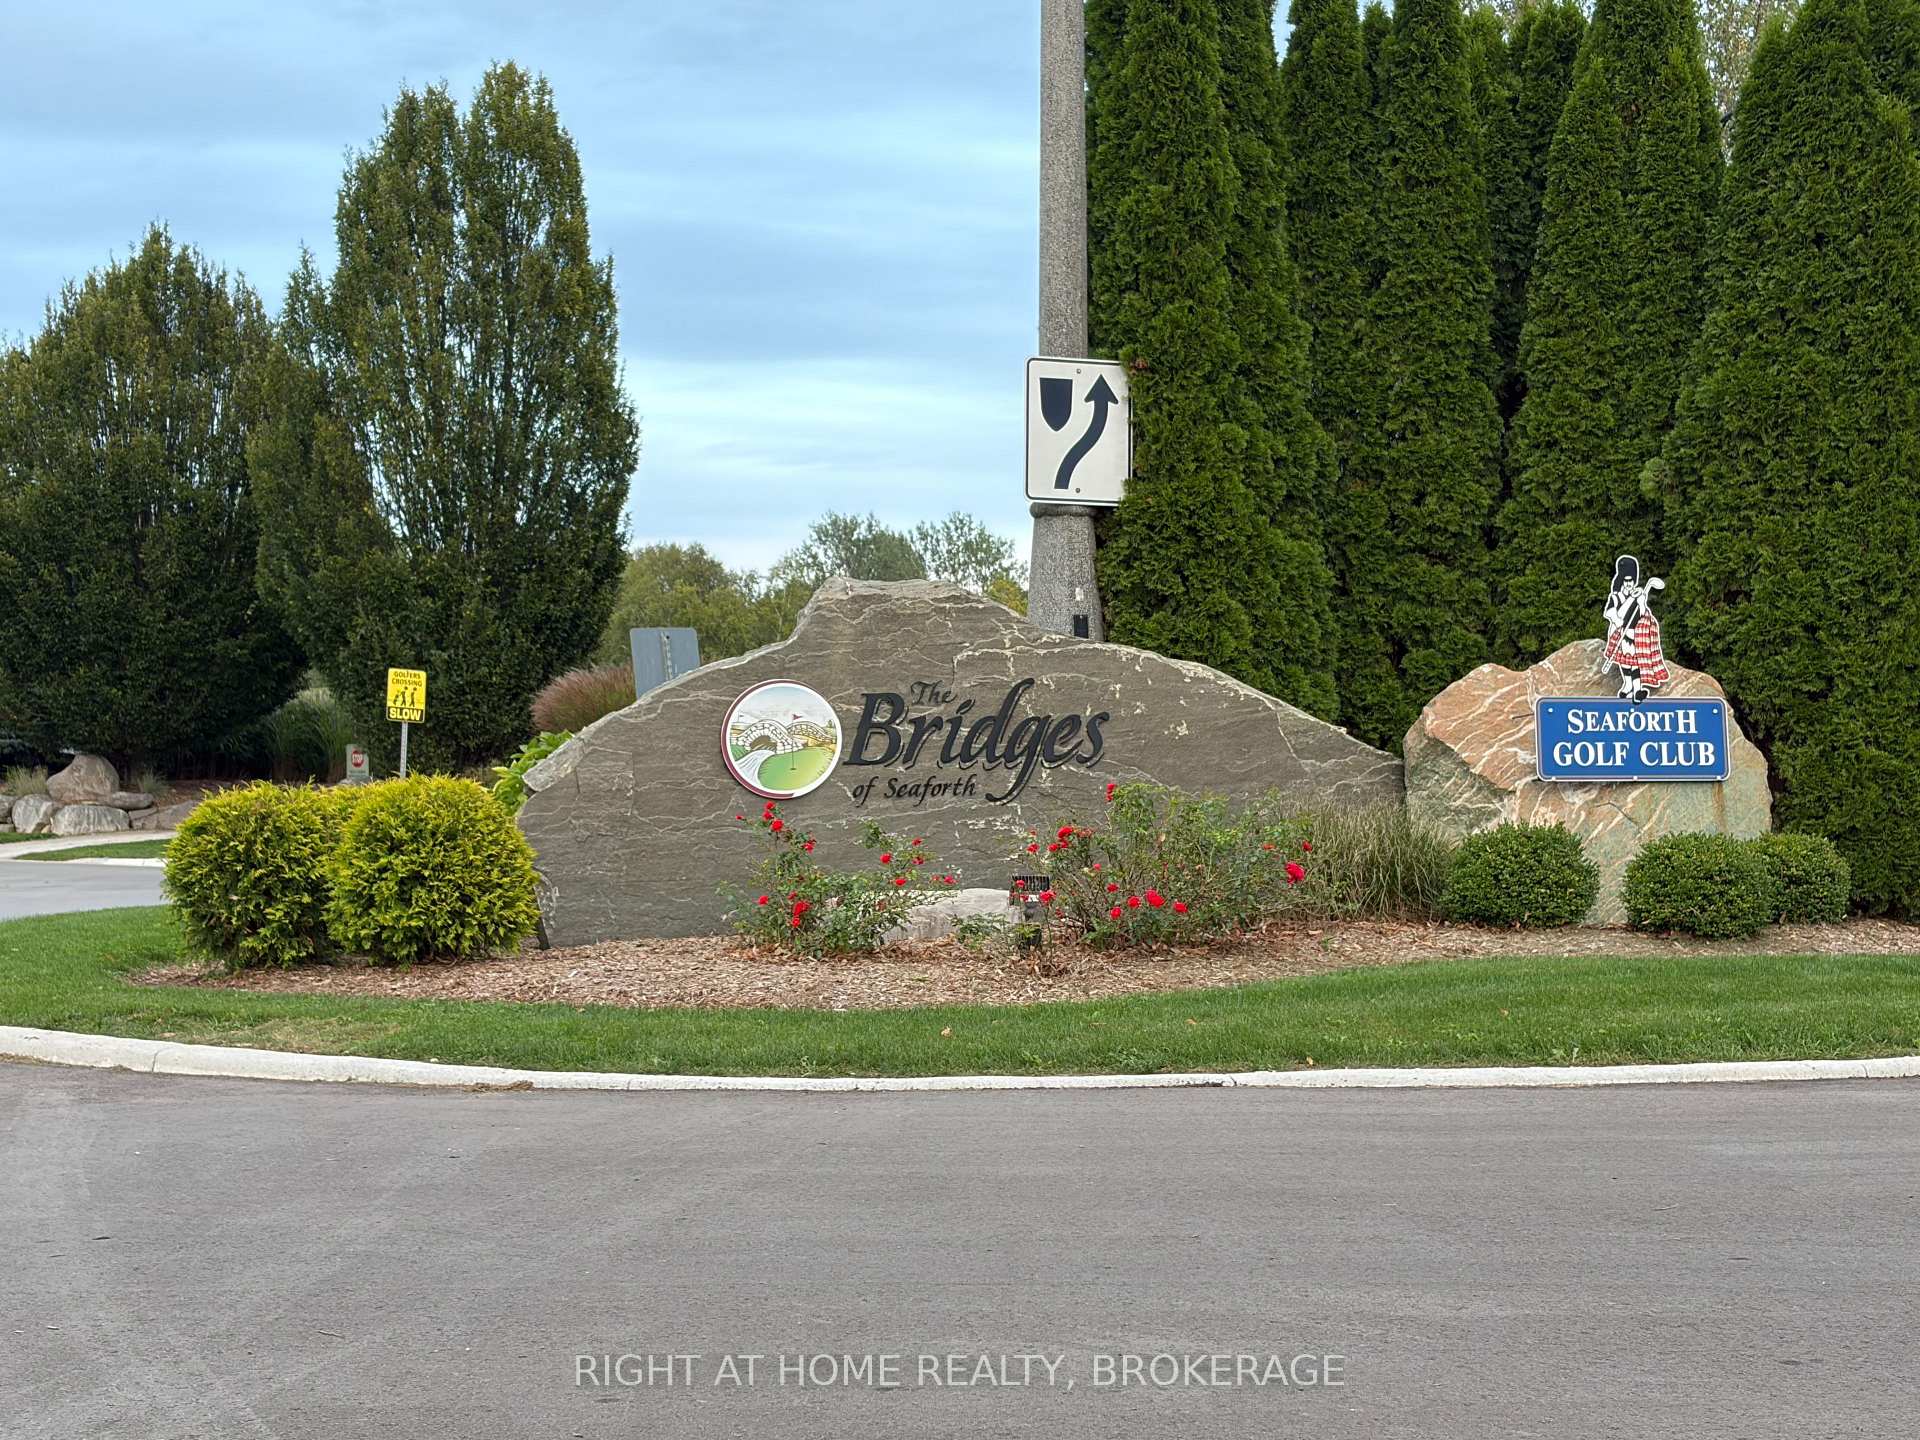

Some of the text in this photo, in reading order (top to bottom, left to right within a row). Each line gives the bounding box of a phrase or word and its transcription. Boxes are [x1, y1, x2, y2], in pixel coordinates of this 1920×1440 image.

[392, 678, 422, 687] CROSSING
[394, 671, 421, 679] GOLFERS
[910, 680, 957, 705] The
[390, 708, 421, 720] SLOW
[842, 677, 1110, 806] Bridges
[1553, 741, 1715, 766] GOLF CLUB
[852, 774, 977, 808] of Seaforth
